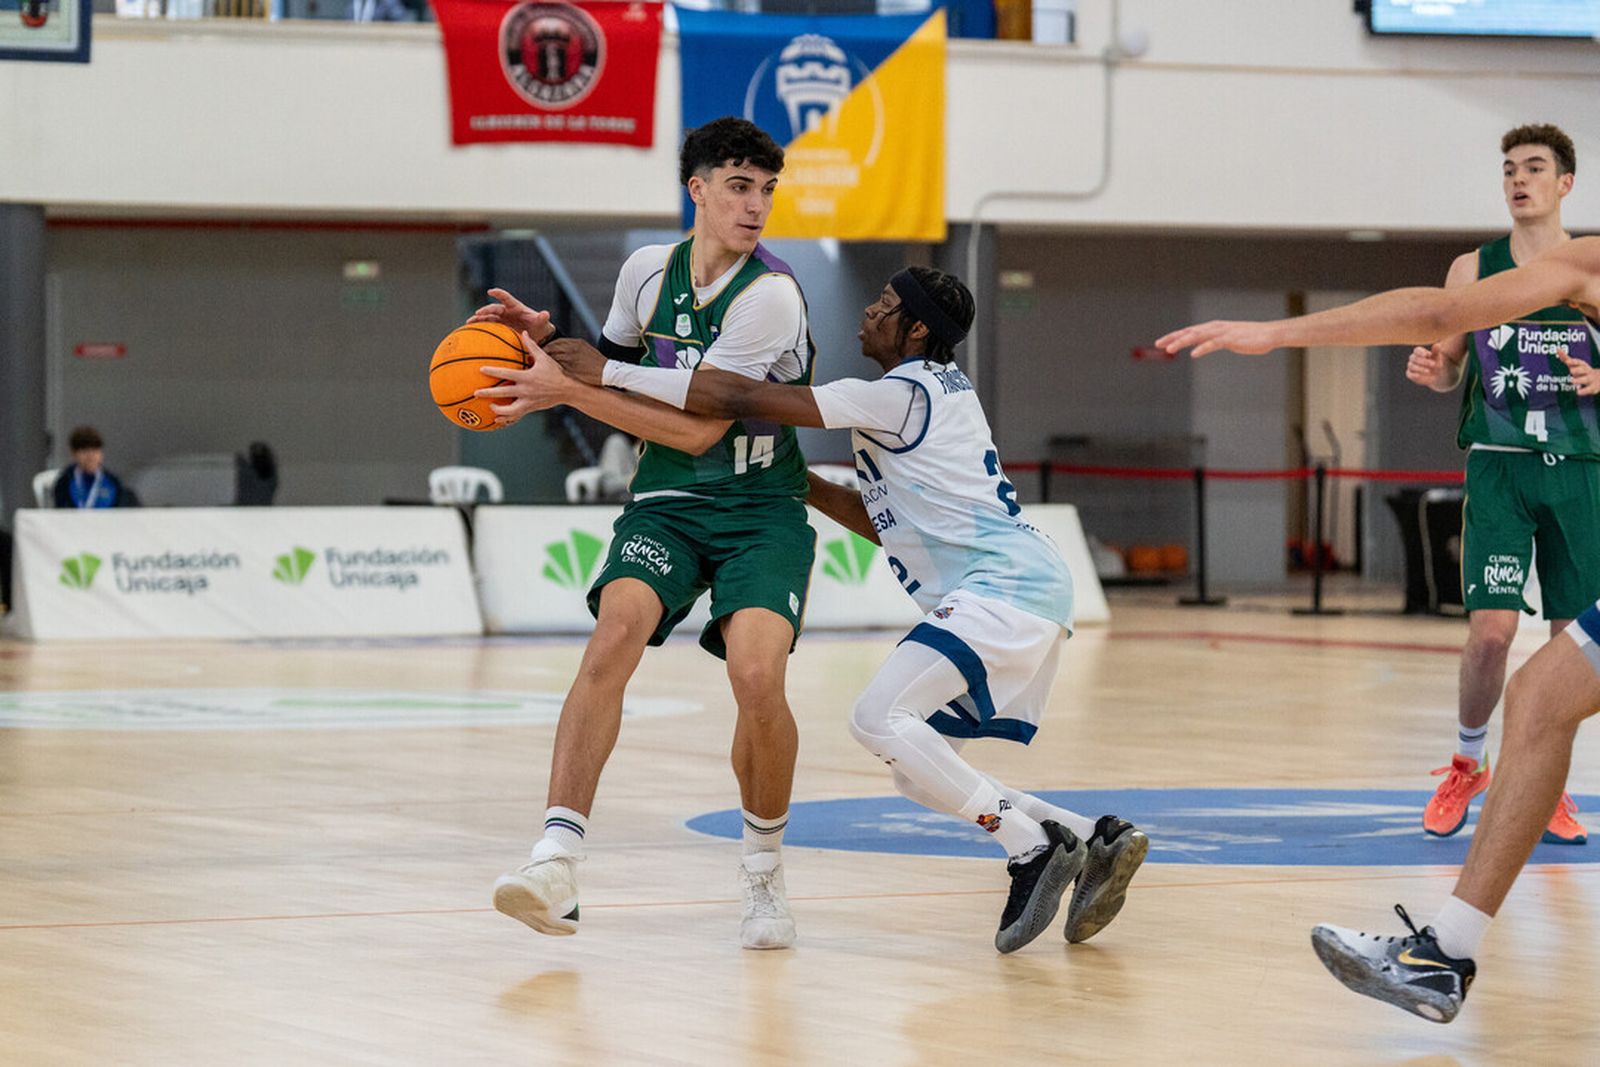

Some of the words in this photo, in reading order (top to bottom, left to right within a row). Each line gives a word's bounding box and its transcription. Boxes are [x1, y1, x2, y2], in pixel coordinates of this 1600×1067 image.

[1518, 328, 1585, 342] Fundación
[1536, 374, 1573, 383] Alhaurí
[1536, 383, 1549, 391] de
[1550, 383, 1559, 391] la
[1524, 410, 1548, 442] 4
[734, 435, 774, 474] 14
[111, 549, 241, 570] Fundación
[325, 545, 450, 565] Fundación
[622, 555, 660, 577] DENTAL
[114, 574, 210, 595] Unicaja
[328, 570, 419, 592] Unicaja
[1488, 586, 1519, 595] DENTAL
